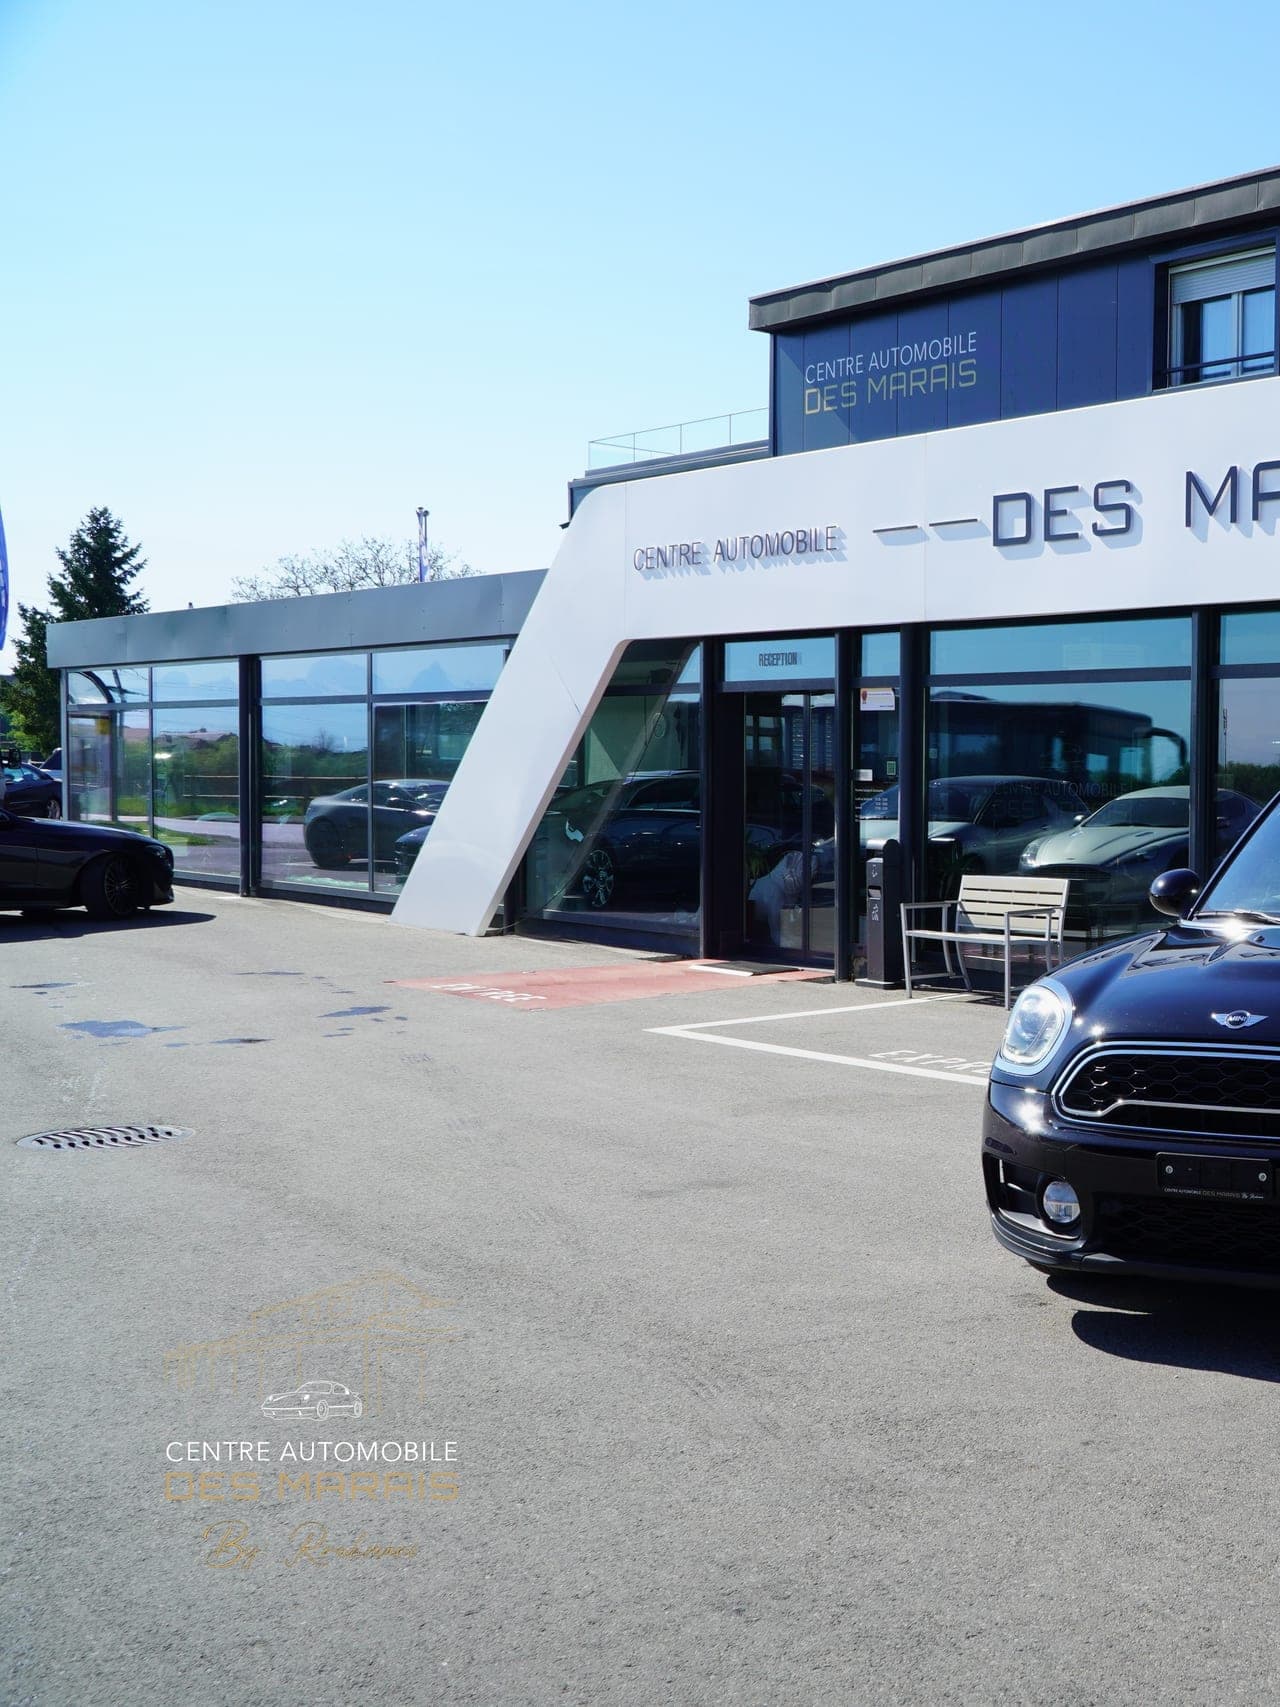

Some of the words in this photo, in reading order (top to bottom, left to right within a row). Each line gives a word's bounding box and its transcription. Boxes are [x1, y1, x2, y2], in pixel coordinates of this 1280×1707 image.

[804, 355, 864, 384] CENTRE
[868, 331, 977, 371] AUTOMOBILE
[804, 383, 857, 415] DES
[867, 358, 977, 405] MARAIS
[992, 479, 1133, 548] DES
[633, 541, 703, 571] CENTRE
[713, 525, 838, 562] AUTOMOBILE
[758, 651, 798, 668] RECEPTION
